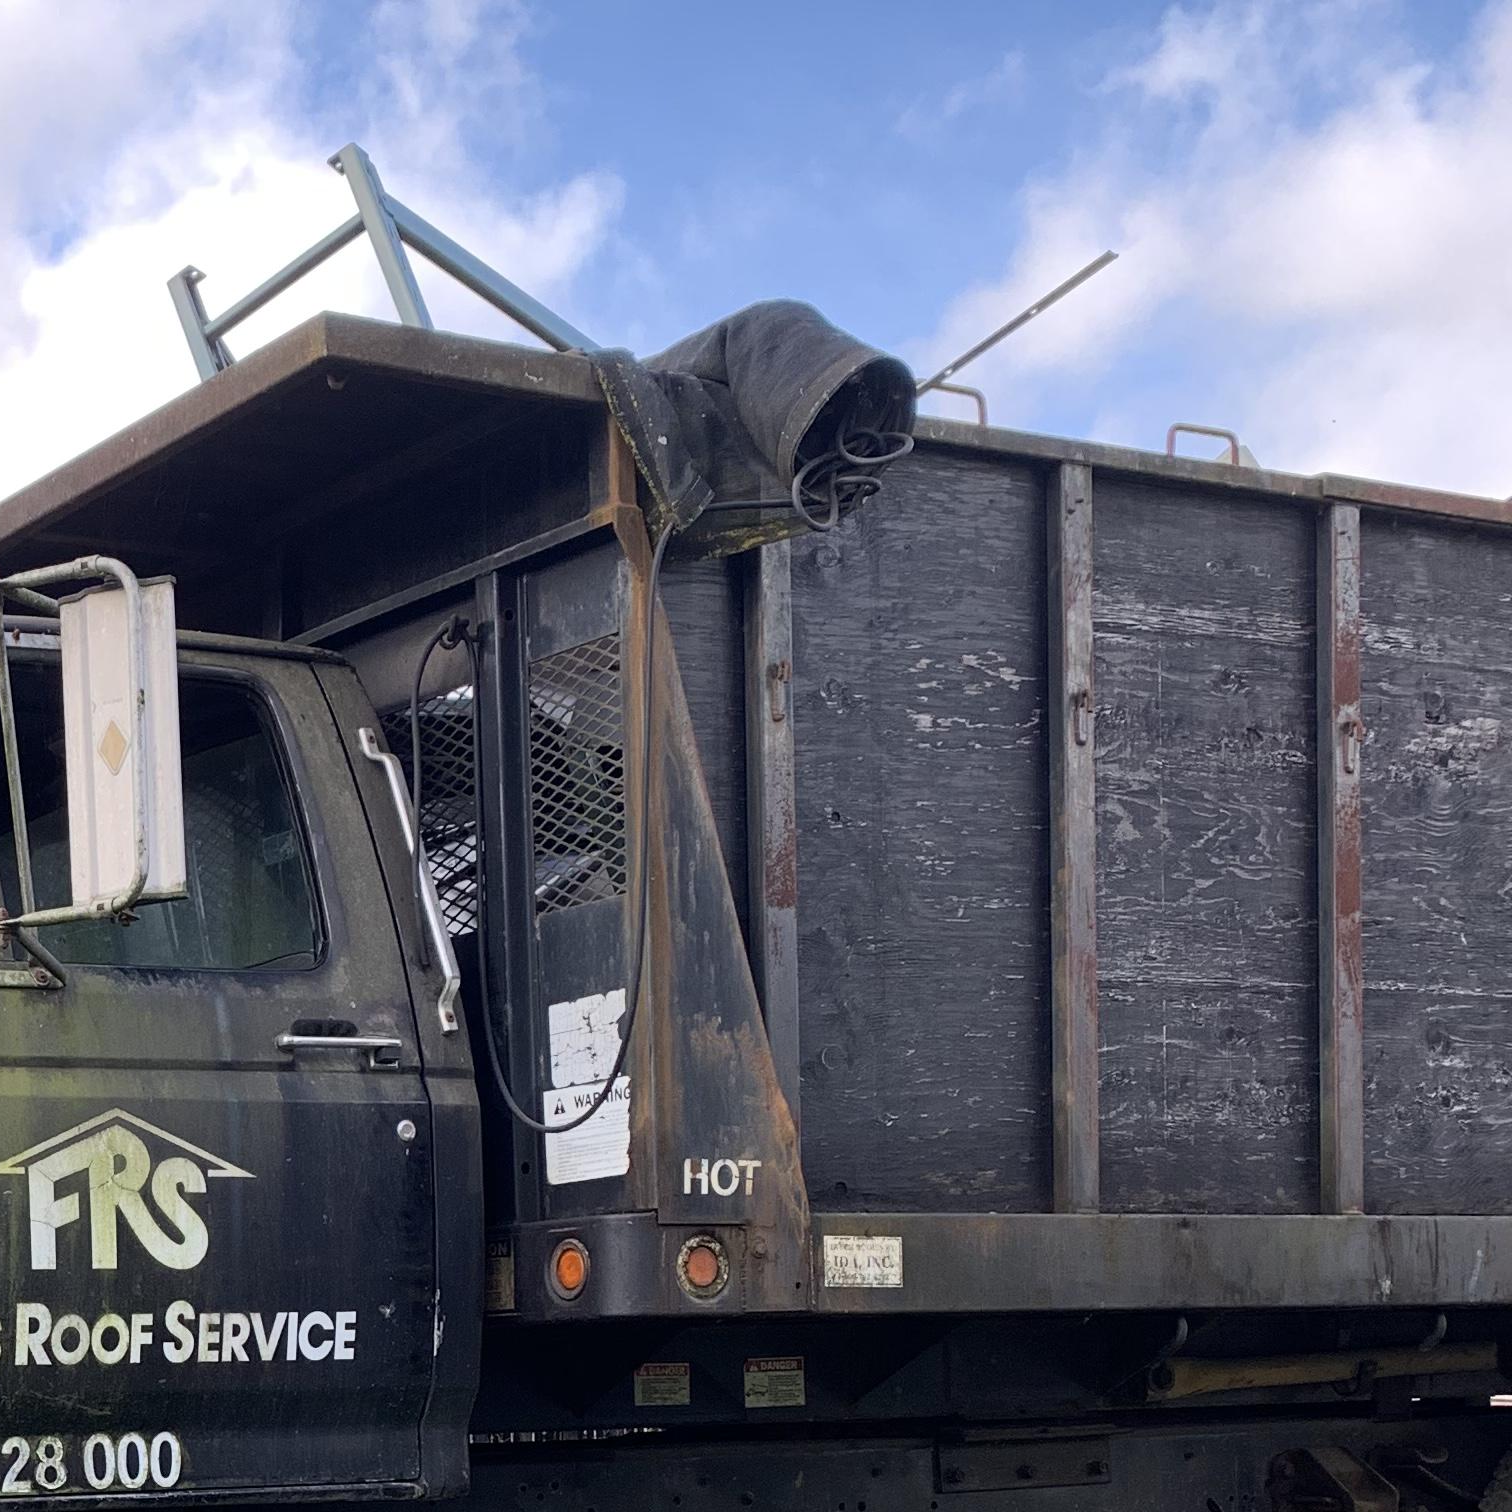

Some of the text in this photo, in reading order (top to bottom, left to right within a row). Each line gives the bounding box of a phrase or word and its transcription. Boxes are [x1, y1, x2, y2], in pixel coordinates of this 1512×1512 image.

[573, 1086, 631, 1108] WARING
[28, 1123, 209, 1271] FRS
[683, 1158, 762, 1197] HOT
[15, 1301, 153, 1367] ROOF
[163, 1300, 357, 1364] SERVICE
[760, 1360, 798, 1371] DANGER
[1, 1430, 182, 1494] 28 000
